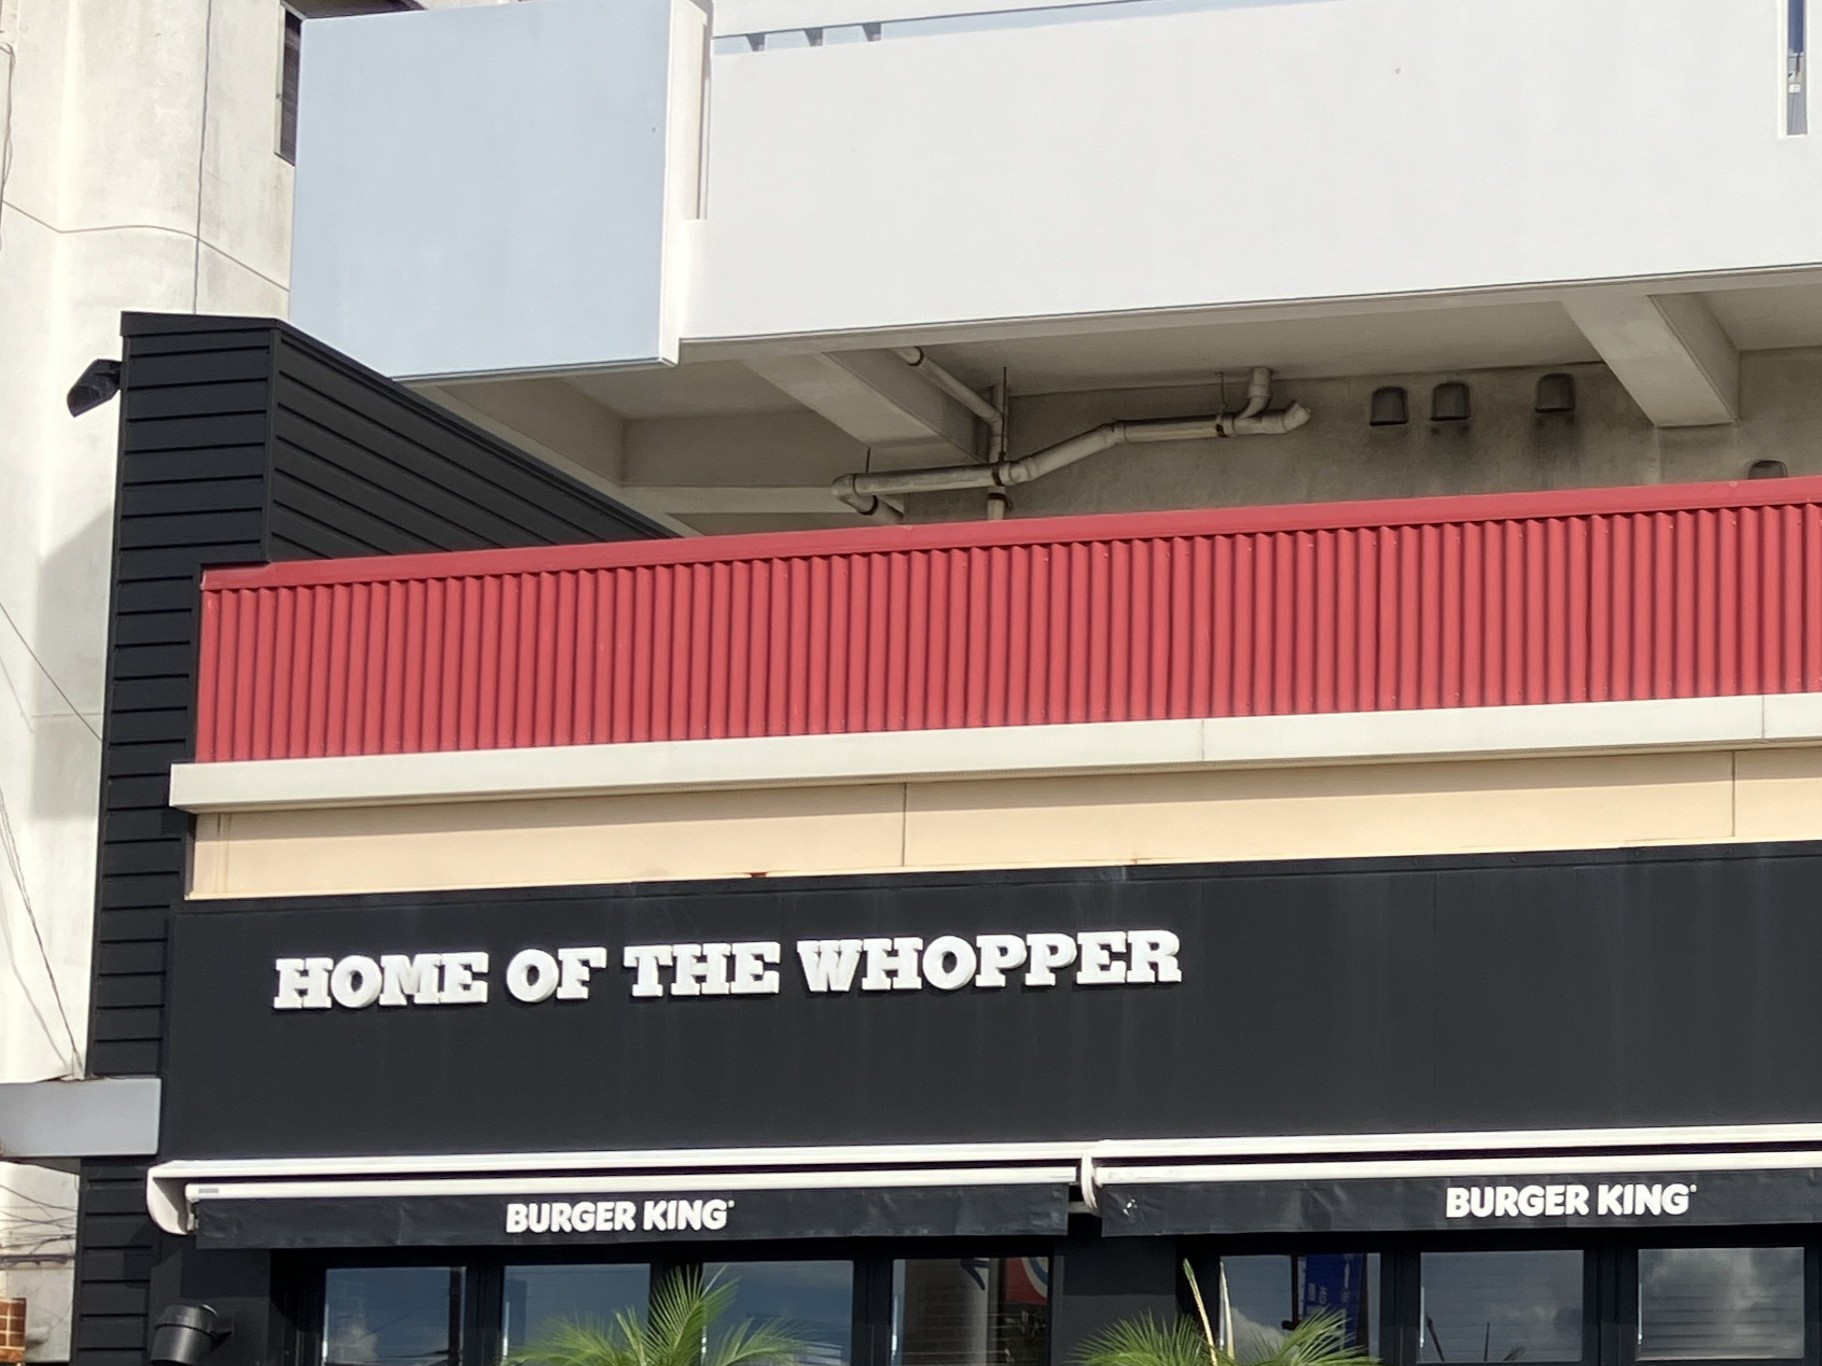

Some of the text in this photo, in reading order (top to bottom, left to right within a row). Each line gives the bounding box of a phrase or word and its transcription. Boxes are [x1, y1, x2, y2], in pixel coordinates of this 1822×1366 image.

[273, 928, 1184, 1010] HOME OF THE WHOPPER
[506, 1199, 728, 1233] BURGER KING
[1446, 1183, 1689, 1217] BURGER KING
